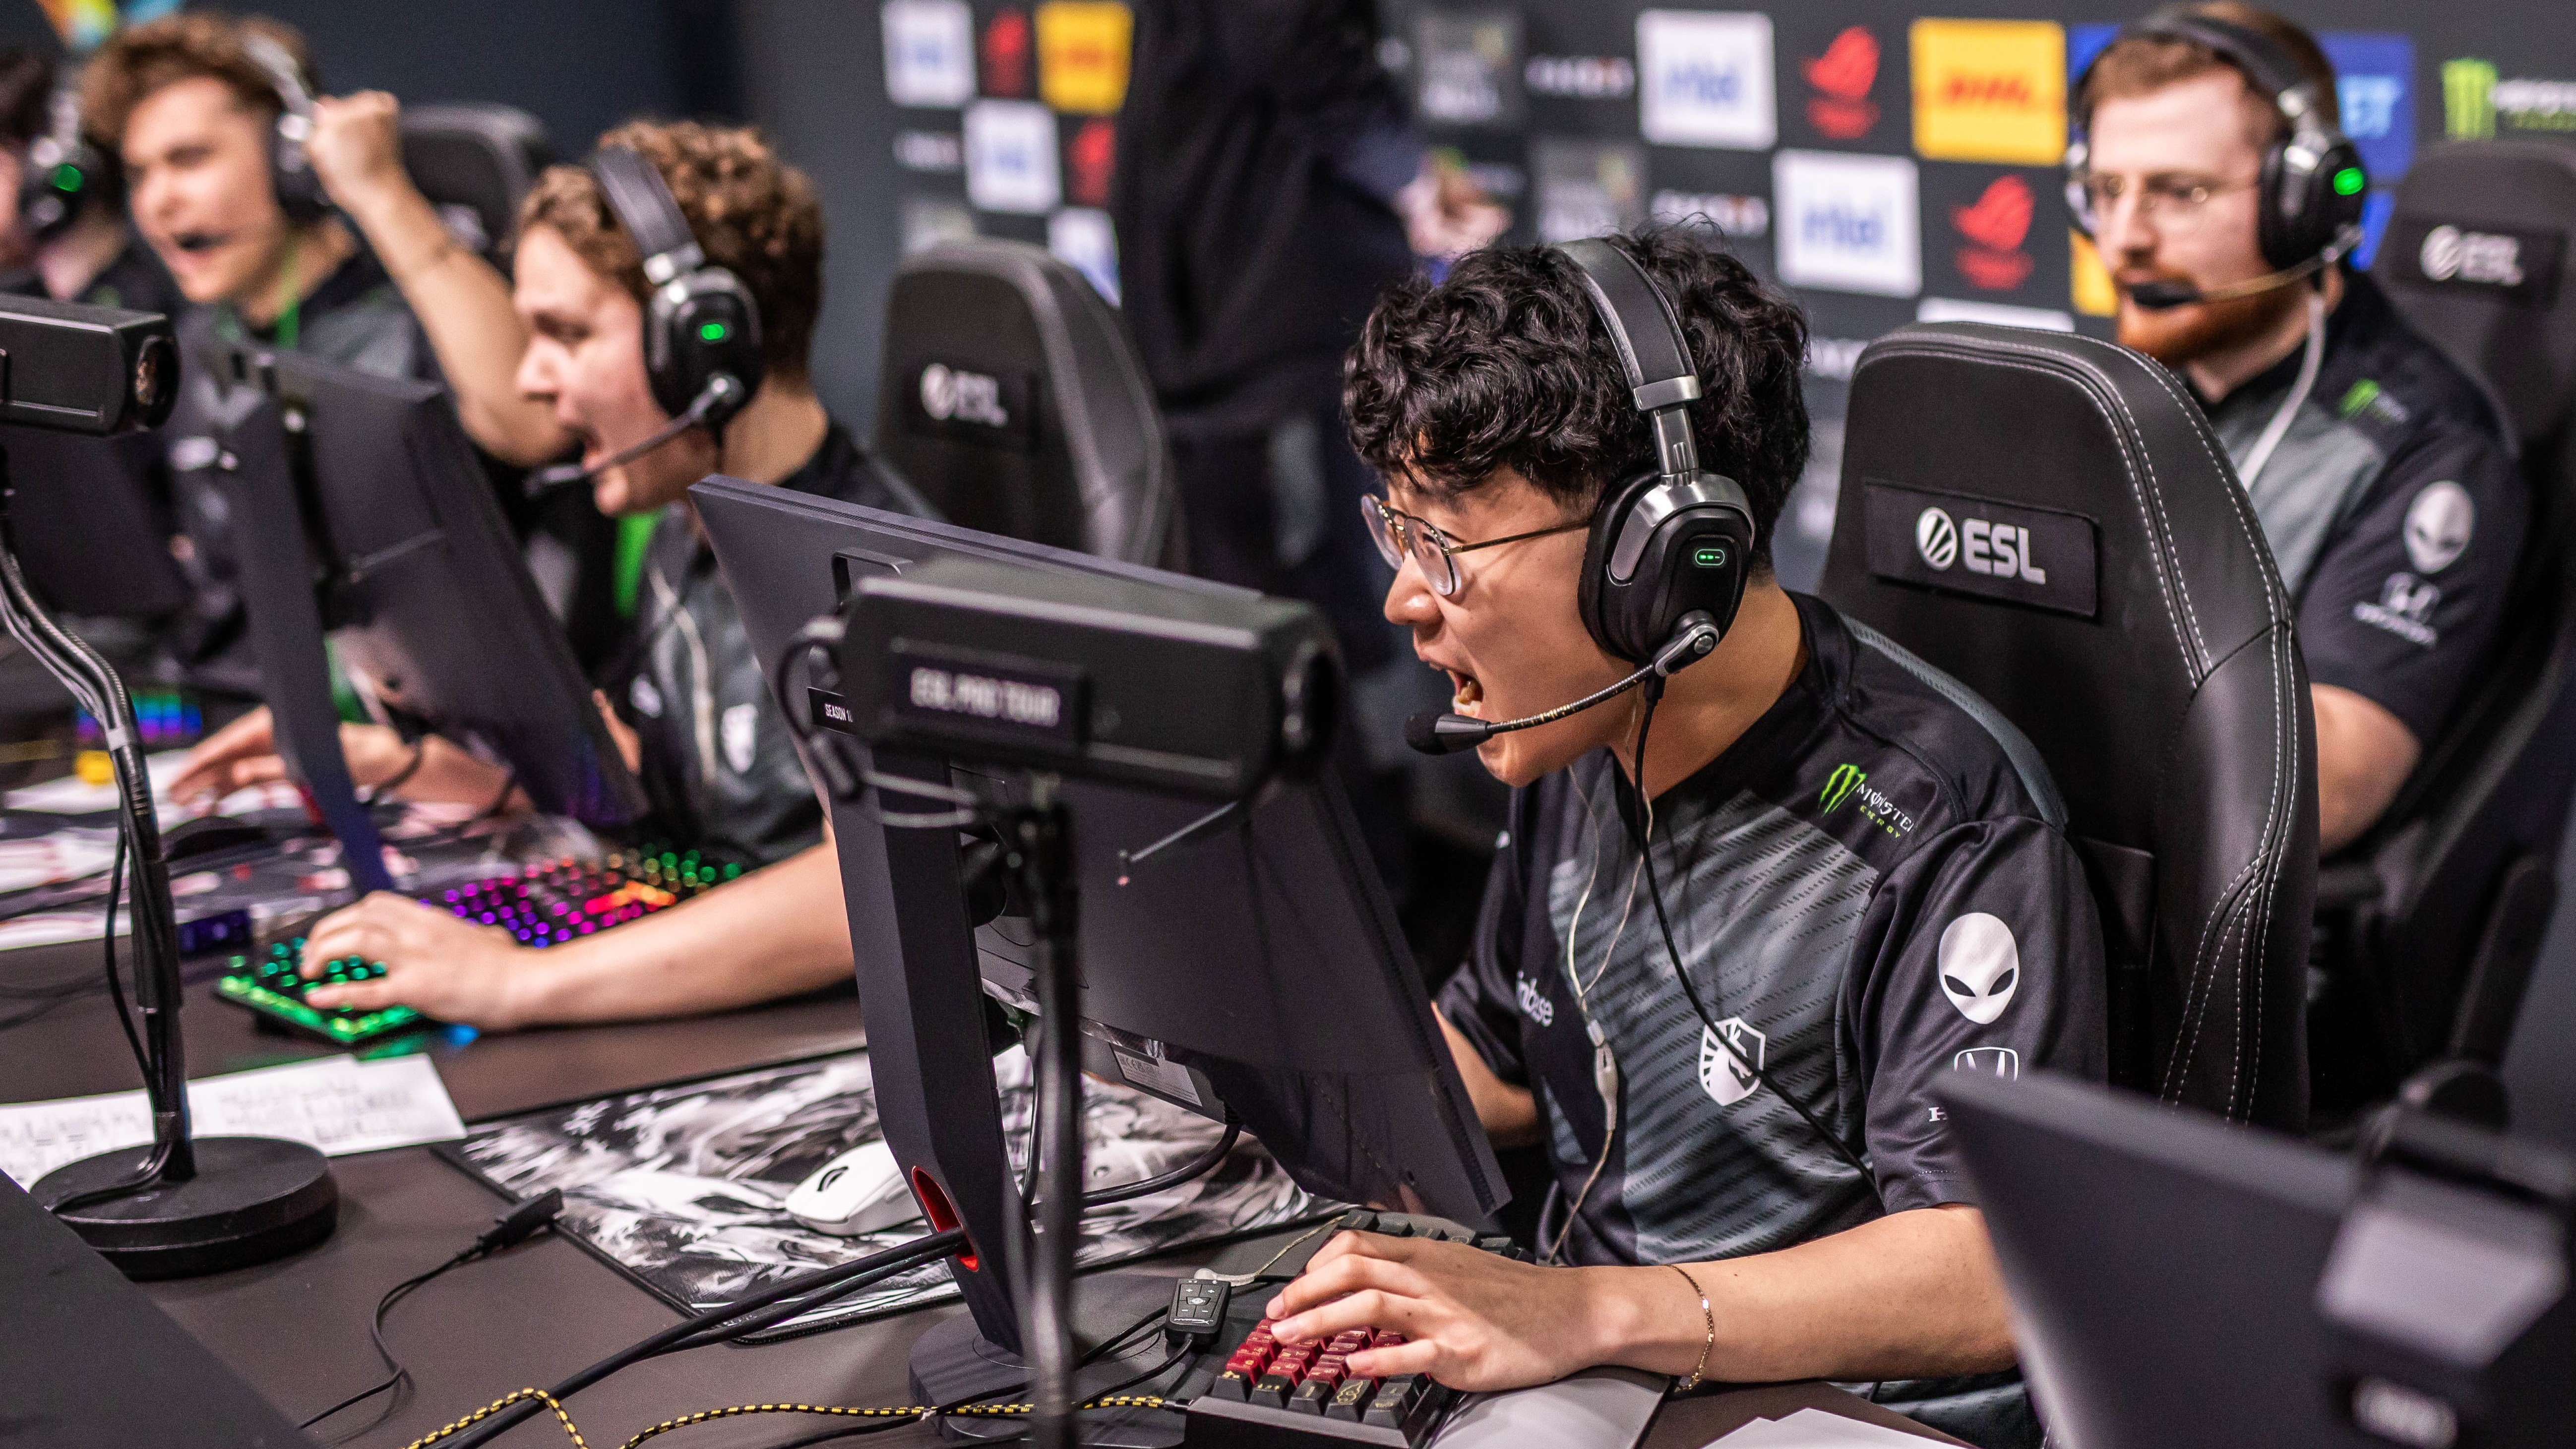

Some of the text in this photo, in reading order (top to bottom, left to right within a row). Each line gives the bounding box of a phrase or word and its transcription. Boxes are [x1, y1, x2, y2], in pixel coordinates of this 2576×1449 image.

[2338, 75, 2397, 139] ET
[1962, 518, 2046, 585] ESL
[824, 703, 847, 722] SEASON
[1857, 783, 1914, 833] MONSTE
